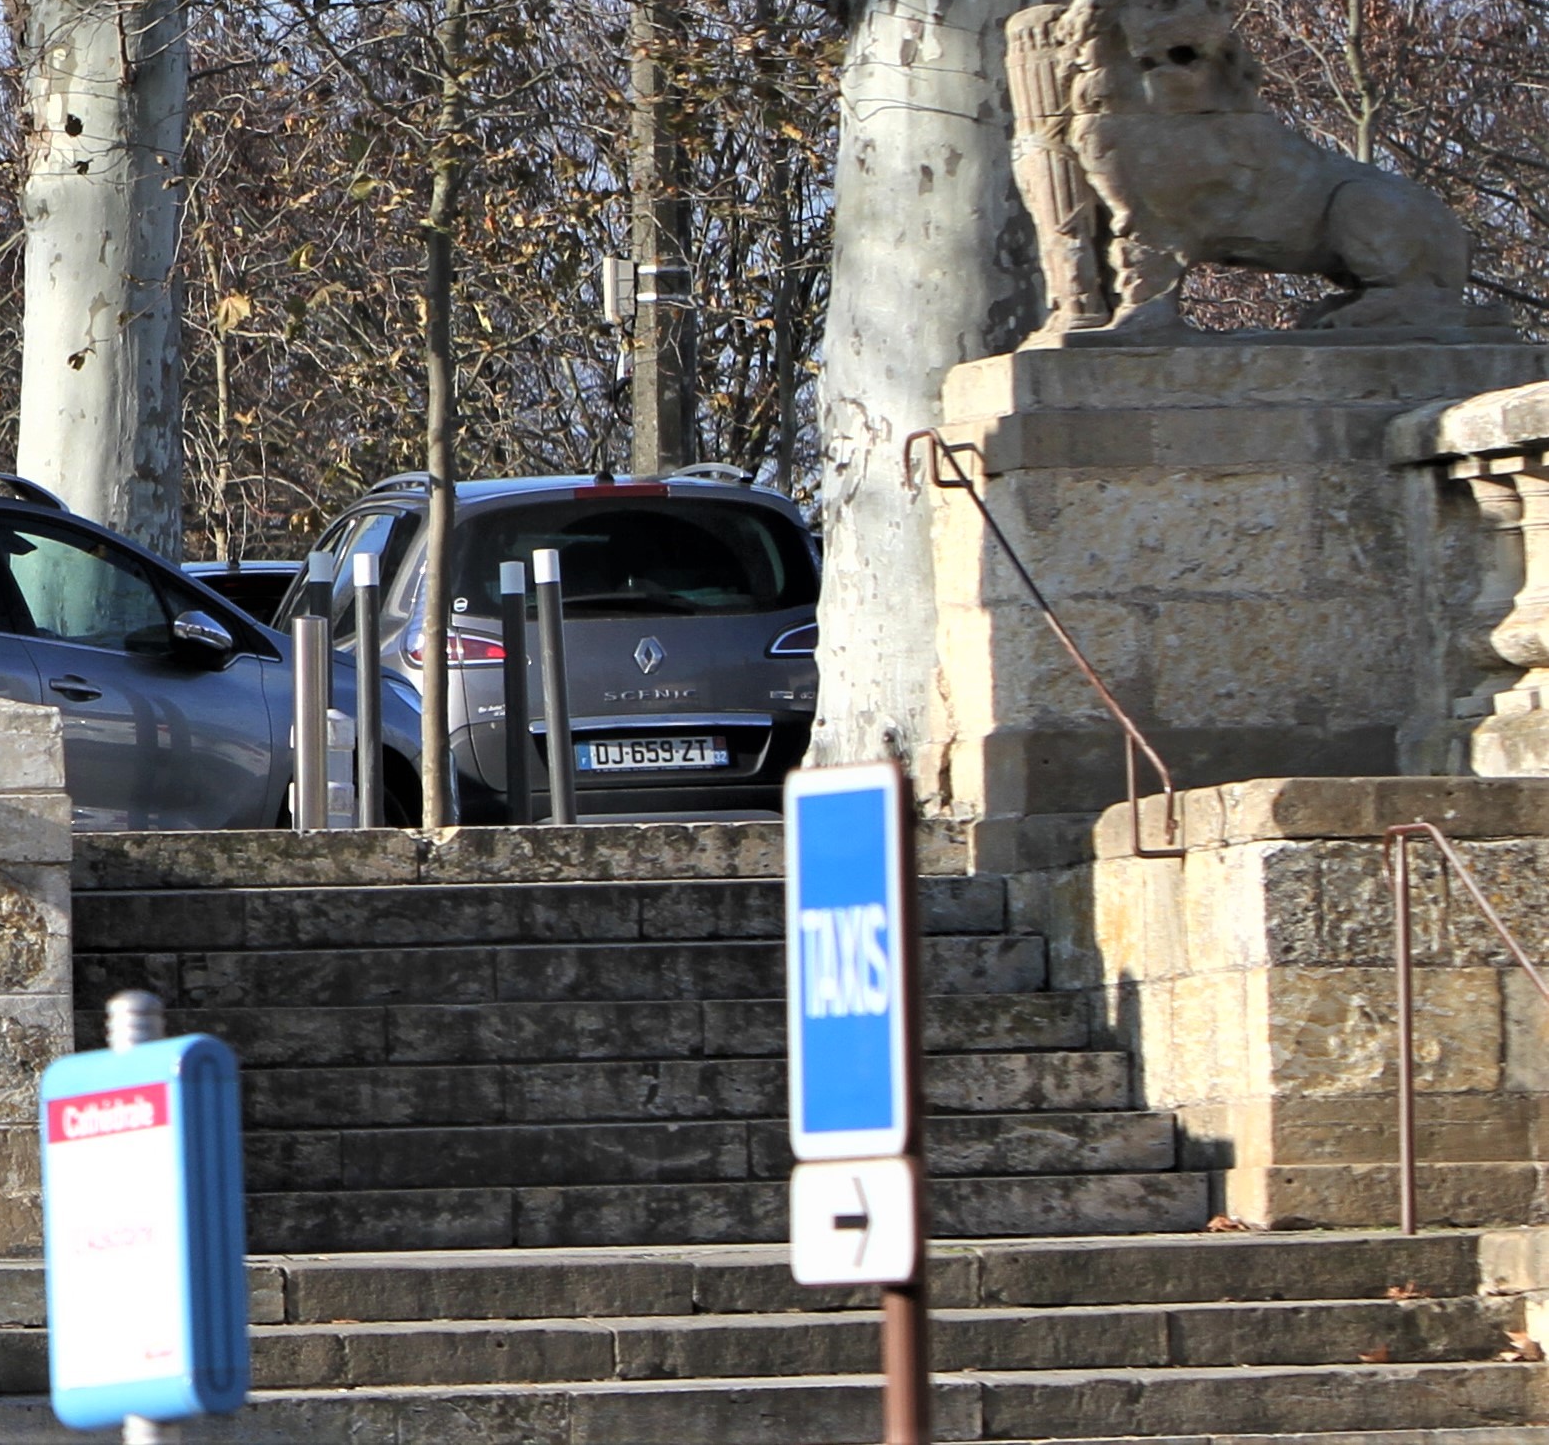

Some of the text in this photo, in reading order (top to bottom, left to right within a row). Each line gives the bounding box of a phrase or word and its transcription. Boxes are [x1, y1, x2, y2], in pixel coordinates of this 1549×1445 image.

[604, 688, 698, 702] SCENIC
[596, 738, 708, 765] DJ-659-ZT
[714, 751, 727, 763] 32
[800, 902, 887, 1019] TAXIS
